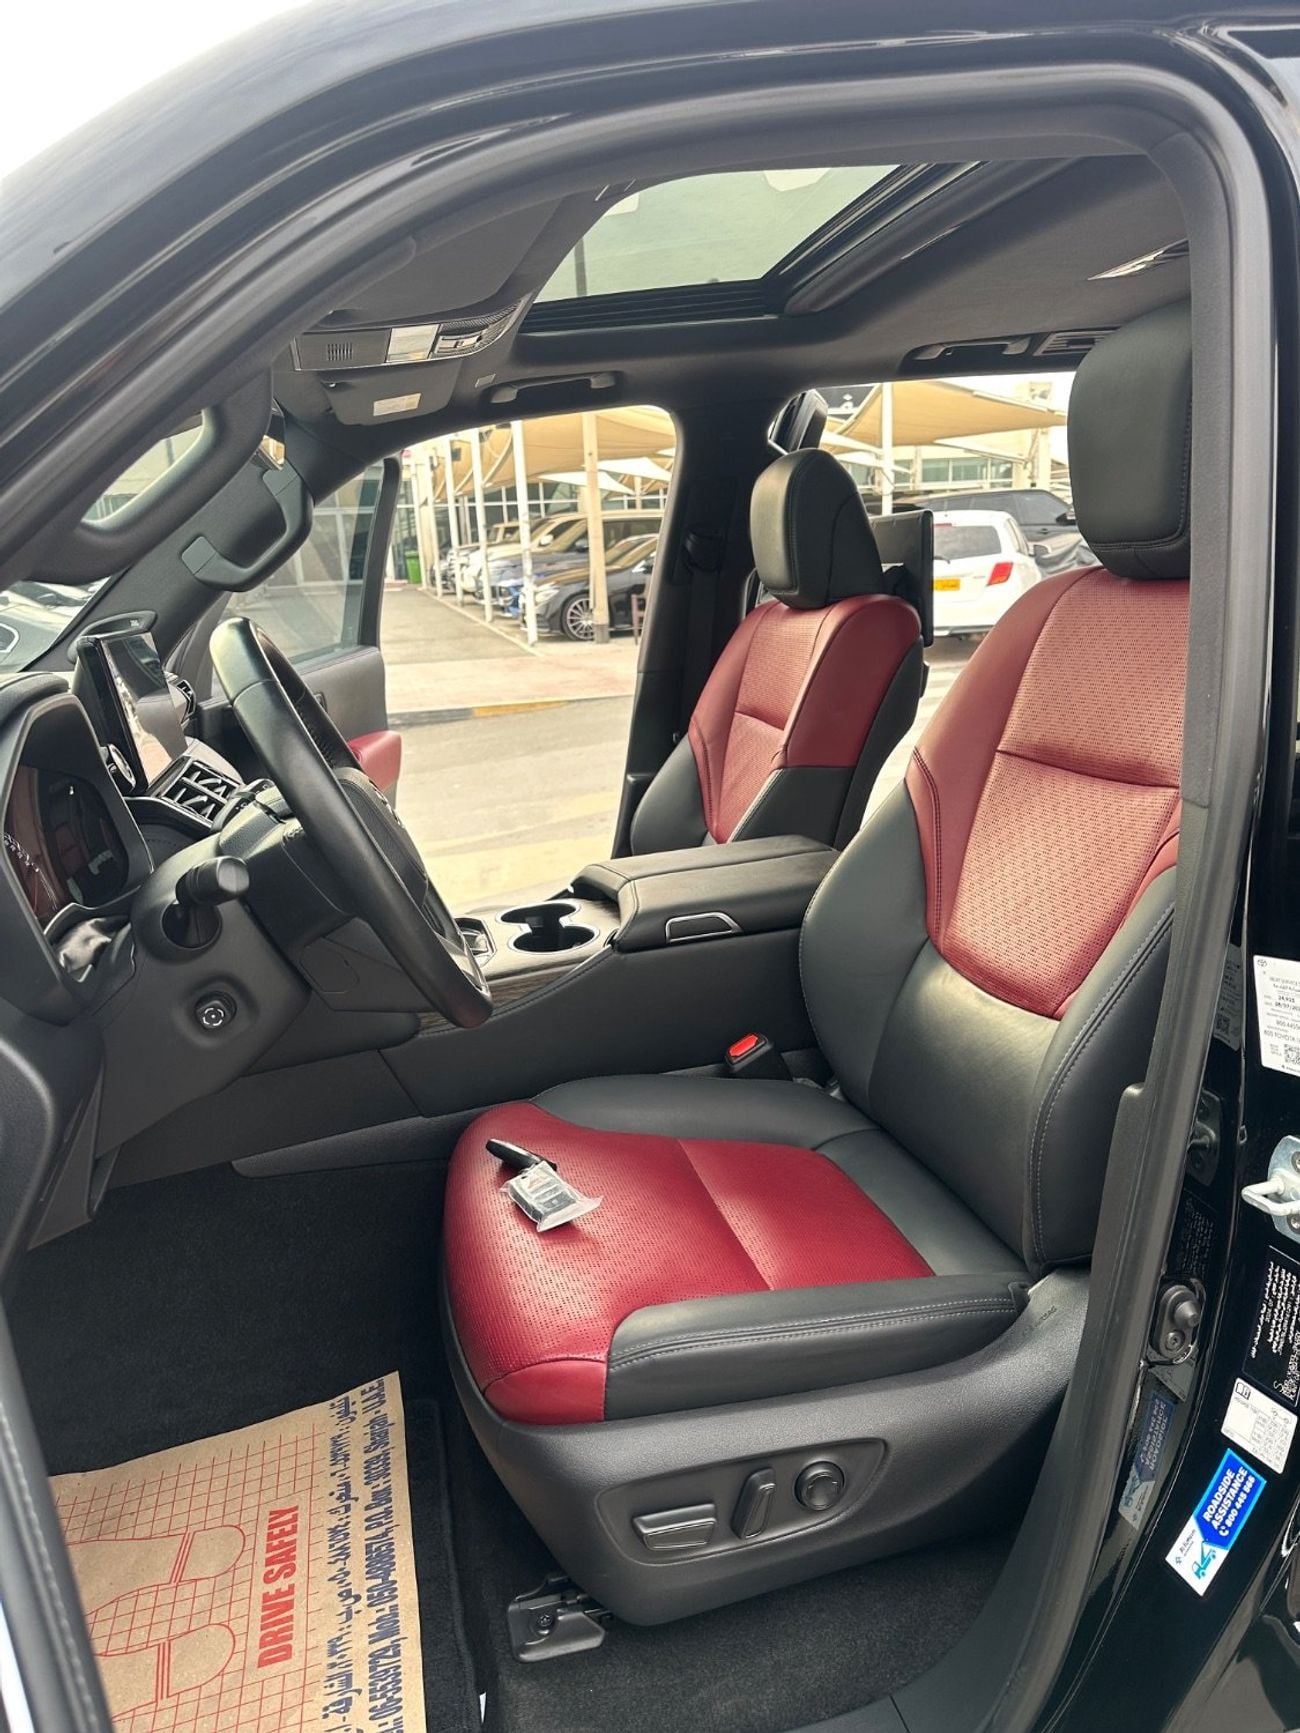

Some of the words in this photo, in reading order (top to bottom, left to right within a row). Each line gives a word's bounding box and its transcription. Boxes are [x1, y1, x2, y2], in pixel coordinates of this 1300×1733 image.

[363, 1413, 395, 1454] Sharjah
[1203, 1469, 1235, 1522] ROADSIDE
[1211, 1466, 1248, 1530] ASSISTANCE
[1225, 1508, 1239, 1527] 800
[263, 1505, 299, 1585] SAFELY
[257, 1583, 295, 1668] DRIVE
[322, 1669, 362, 1719] الشارقة
